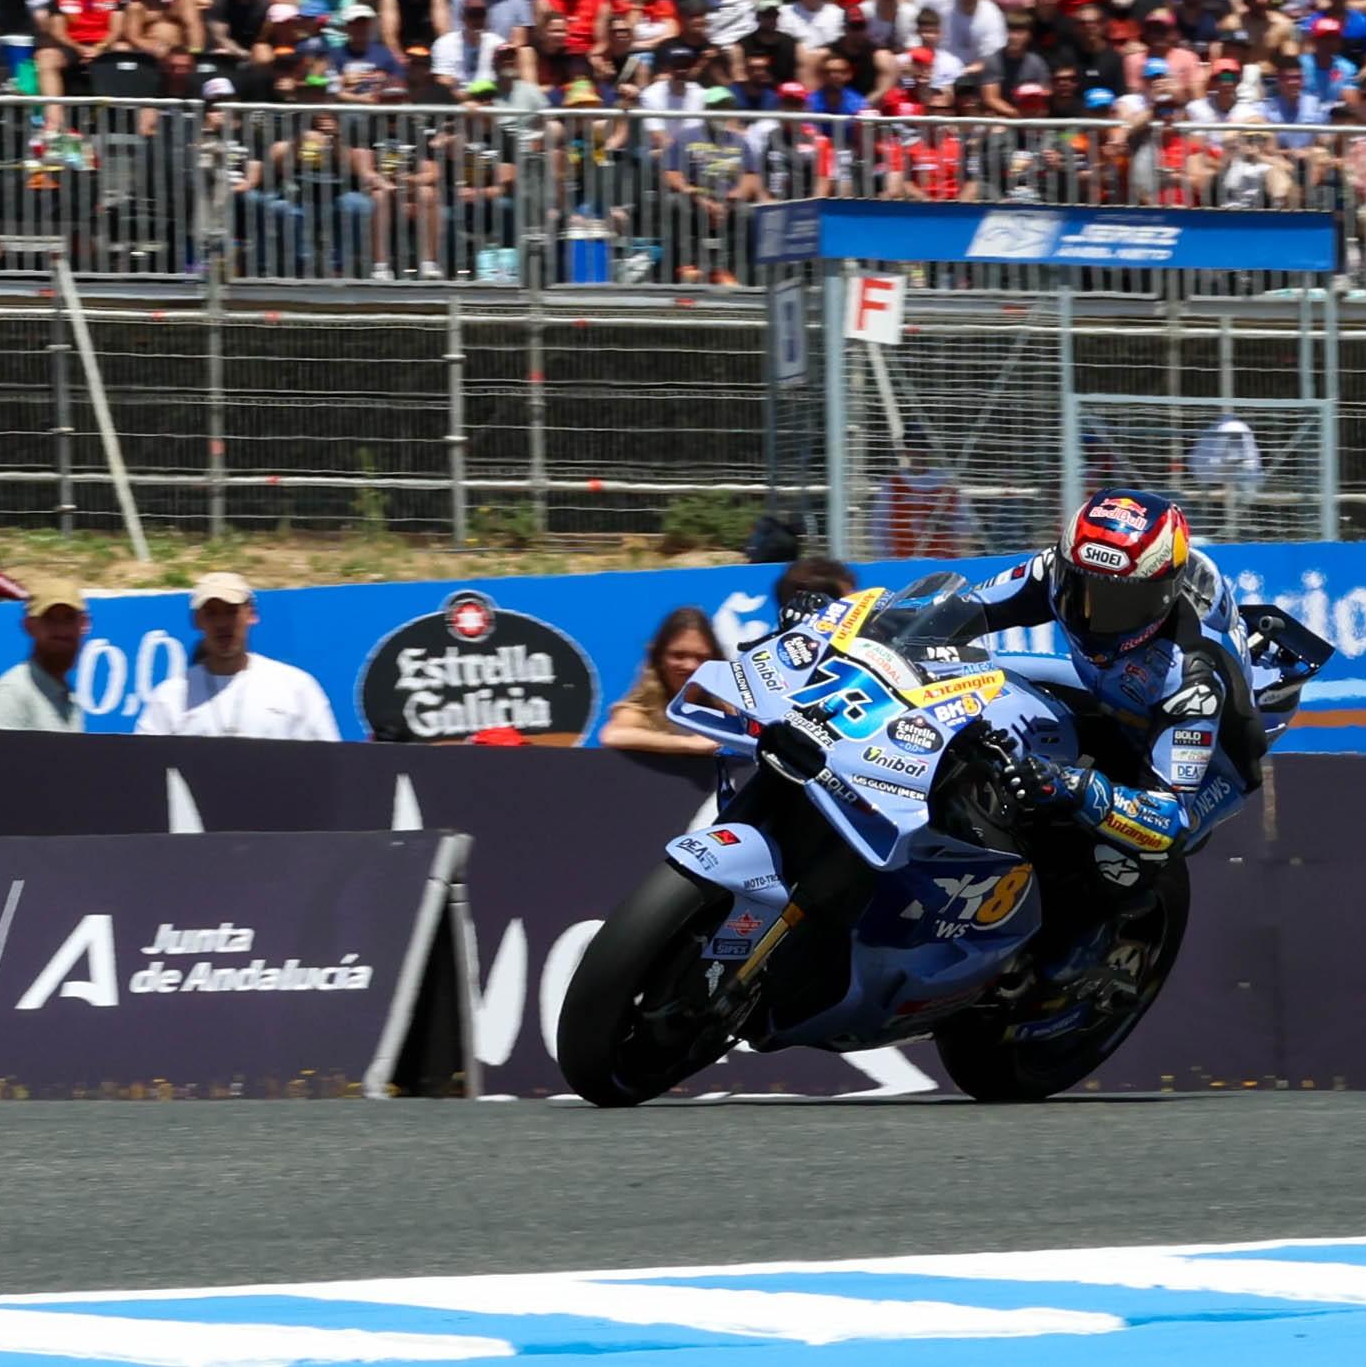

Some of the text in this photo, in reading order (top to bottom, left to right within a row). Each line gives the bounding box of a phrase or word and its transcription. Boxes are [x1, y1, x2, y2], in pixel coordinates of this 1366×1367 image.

[855, 277, 896, 331] F
[1085, 546, 1122, 567] SHOEI
[395, 645, 557, 690] Estrella
[751, 650, 784, 692] Unibat
[783, 655, 909, 742] 73
[923, 673, 997, 701] Antangin
[403, 687, 552, 737] Galicia
[934, 694, 982, 724] BK8
[895, 729, 932, 749] Galicia
[897, 720, 936, 741] Estrella
[1174, 730, 1202, 741] BOLD
[862, 746, 927, 778] Unibat
[867, 779, 898, 794] GLOW
[1106, 813, 1163, 849] Antangin
[1139, 806, 1172, 830] NEWS
[142, 922, 254, 955] Junta
[130, 954, 373, 994] de Andalucía
